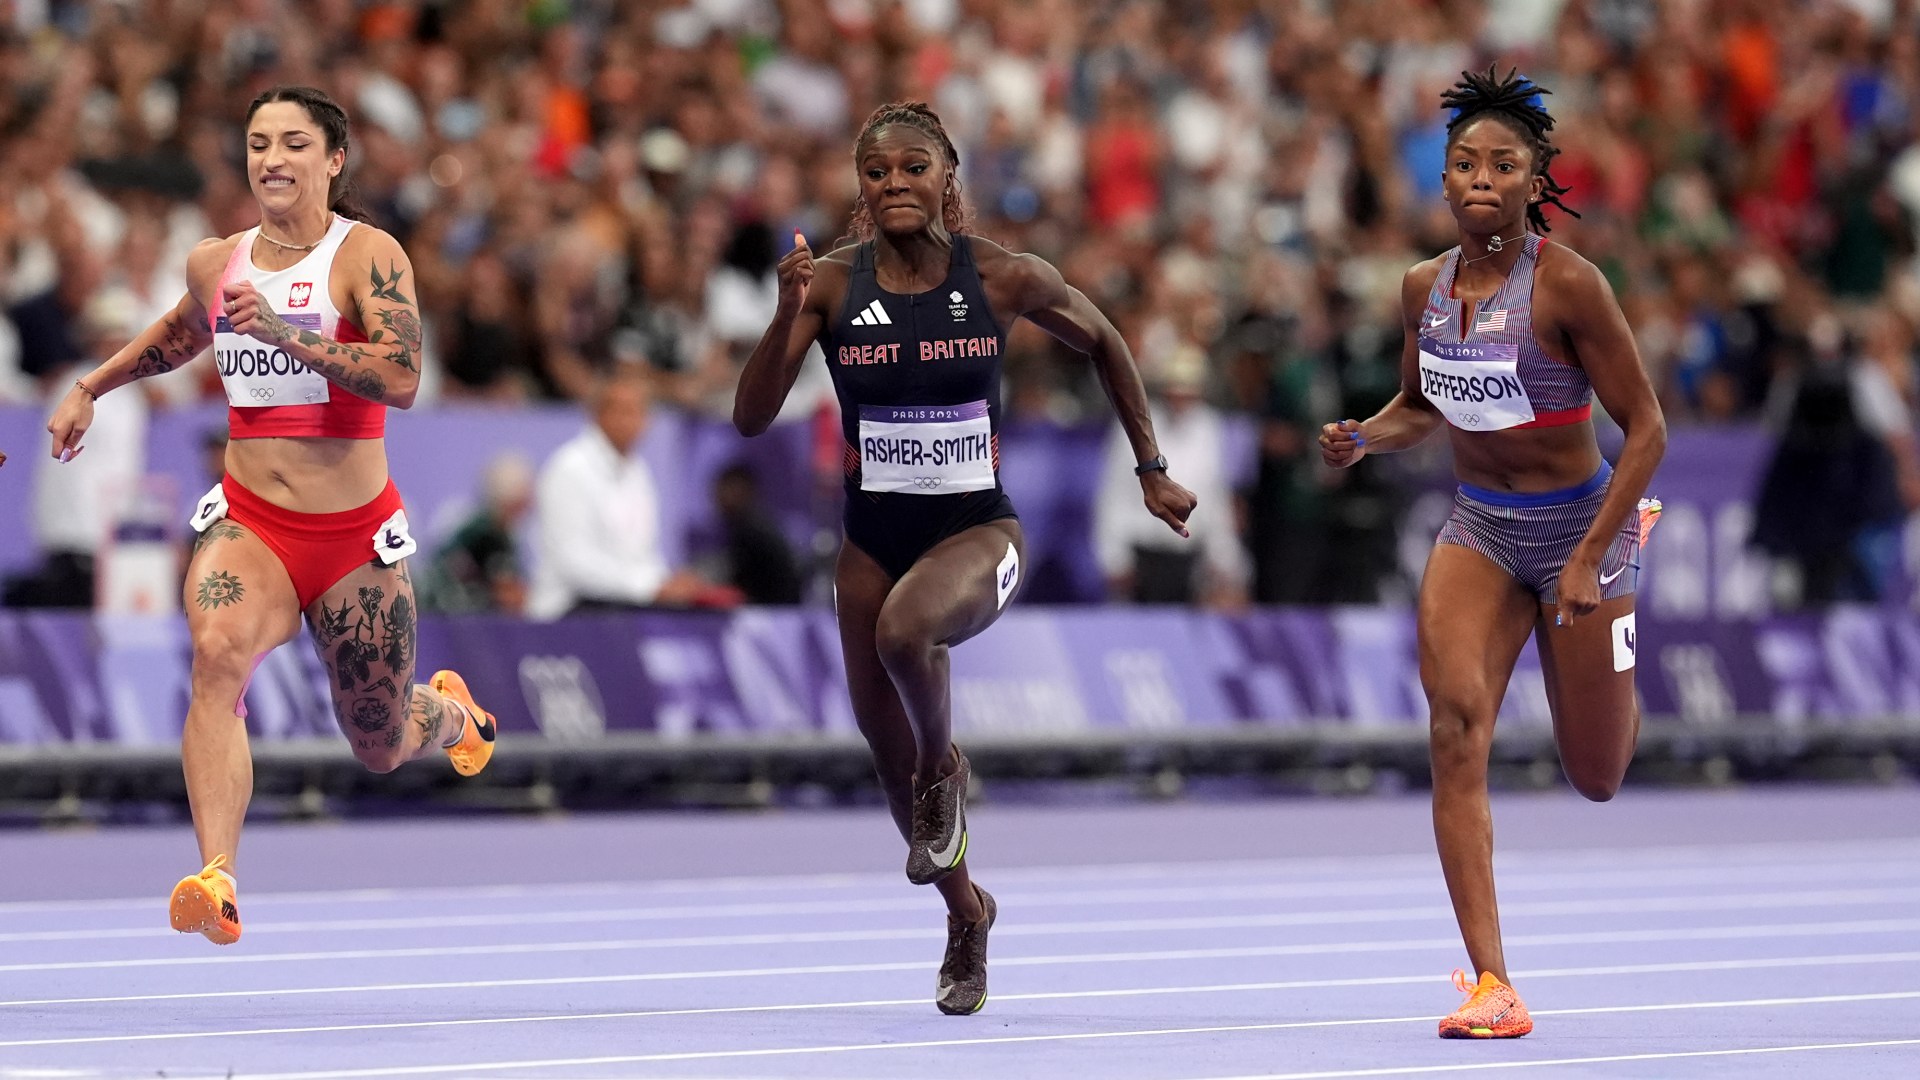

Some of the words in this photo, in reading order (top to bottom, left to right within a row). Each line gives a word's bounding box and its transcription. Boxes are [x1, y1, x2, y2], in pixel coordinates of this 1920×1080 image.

[216, 348, 312, 377] SWOBOD
[838, 343, 901, 366] GREAT
[919, 336, 998, 362] BRITAIN
[1456, 348, 1484, 357] 2024
[1421, 366, 1522, 403] JEFFERSON
[892, 410, 926, 419] PARIS
[929, 410, 959, 418] 2024
[864, 433, 988, 466] ASHER-SMITH
[1624, 627, 1635, 656] 4
